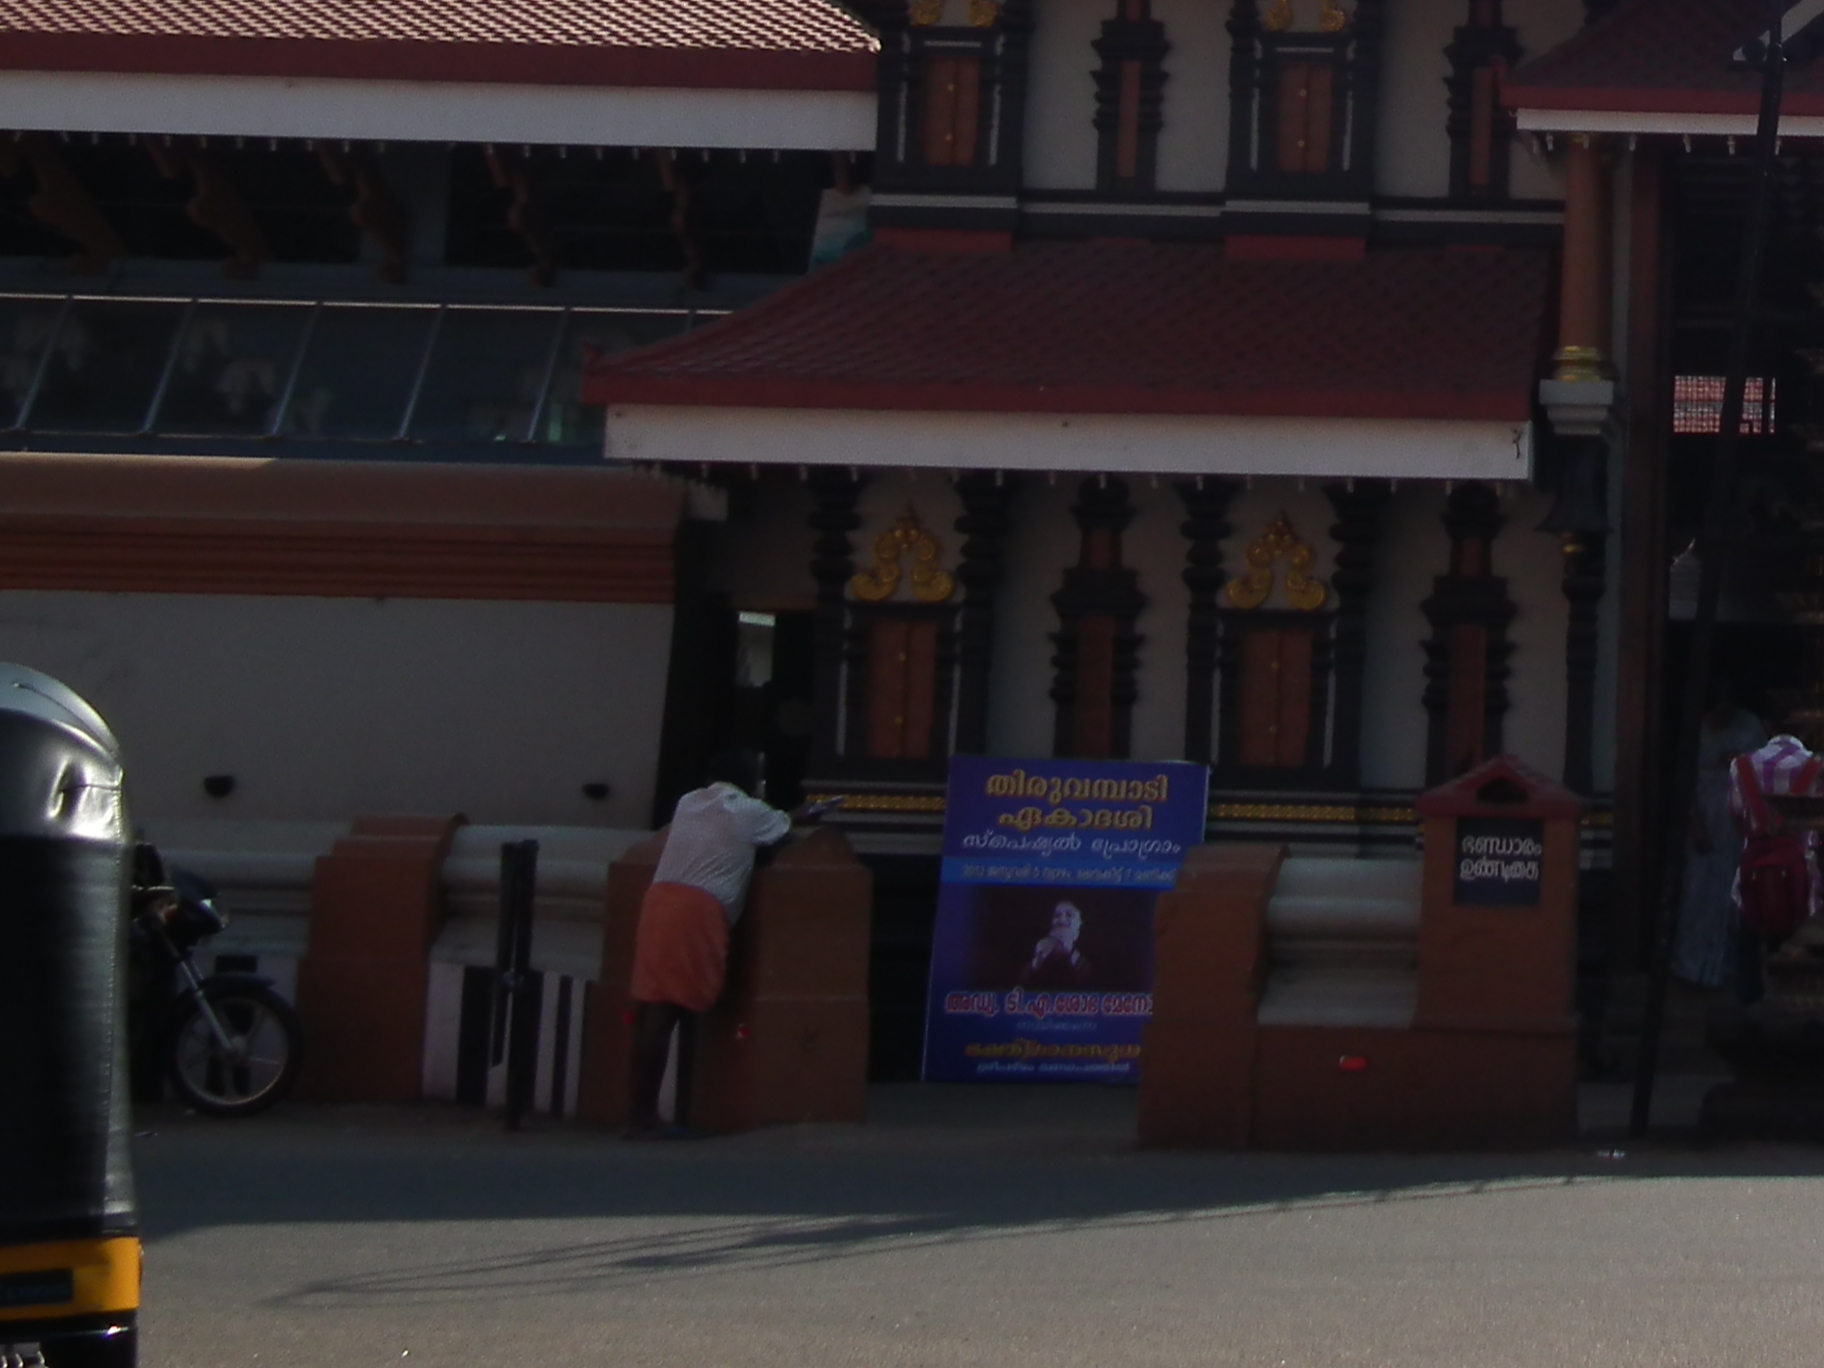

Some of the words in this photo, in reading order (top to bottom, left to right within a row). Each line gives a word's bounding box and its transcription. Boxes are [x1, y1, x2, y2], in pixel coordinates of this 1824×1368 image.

[985, 768, 1169, 805] തിരുവമ്പാടി
[997, 804, 1154, 832] ഏകാദശി
[1461, 834, 1543, 857] ഭണ്ഡാരം
